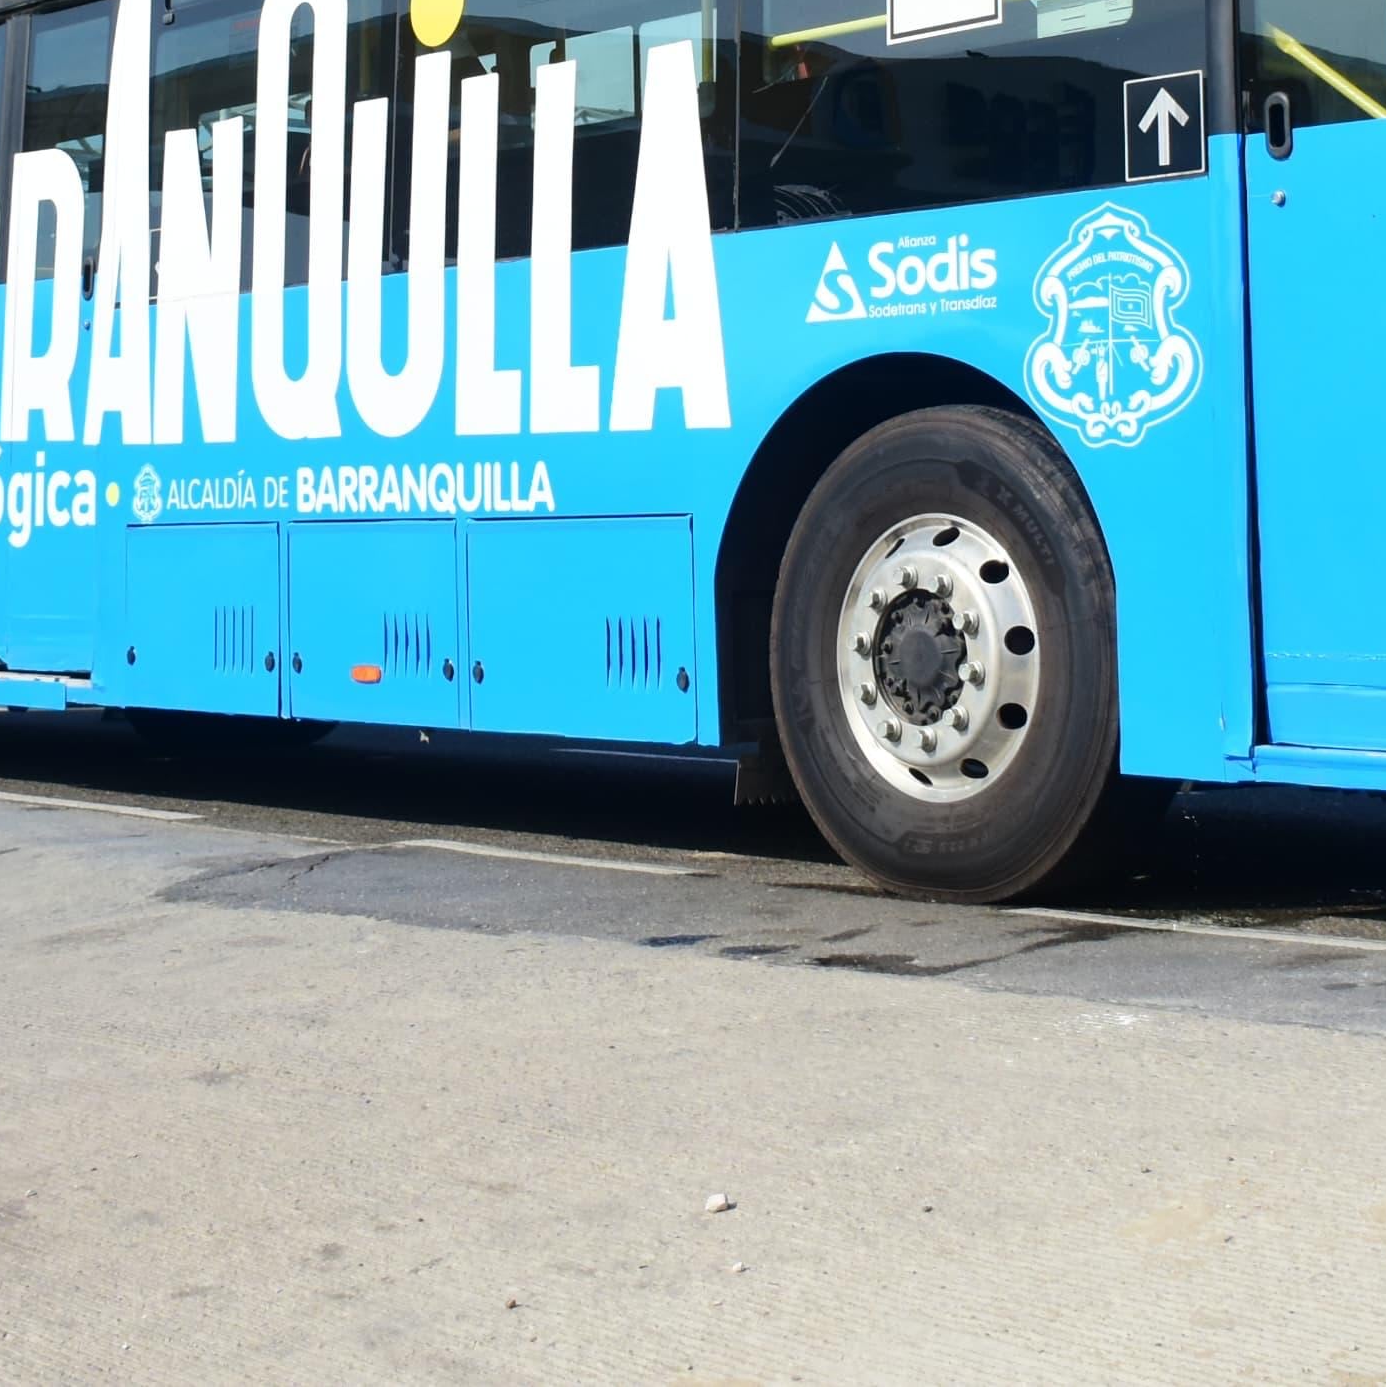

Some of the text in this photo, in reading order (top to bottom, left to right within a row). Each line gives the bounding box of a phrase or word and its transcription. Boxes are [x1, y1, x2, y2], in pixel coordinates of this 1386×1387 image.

[897, 234, 937, 249] Alianza
[868, 233, 997, 298] Sodis
[1092, 251, 1108, 266] DEL
[868, 301, 927, 319] Sodetrans
[929, 301, 937, 317] y
[166, 460, 556, 514] ALCALDÍA DE BARRANQUILLA
